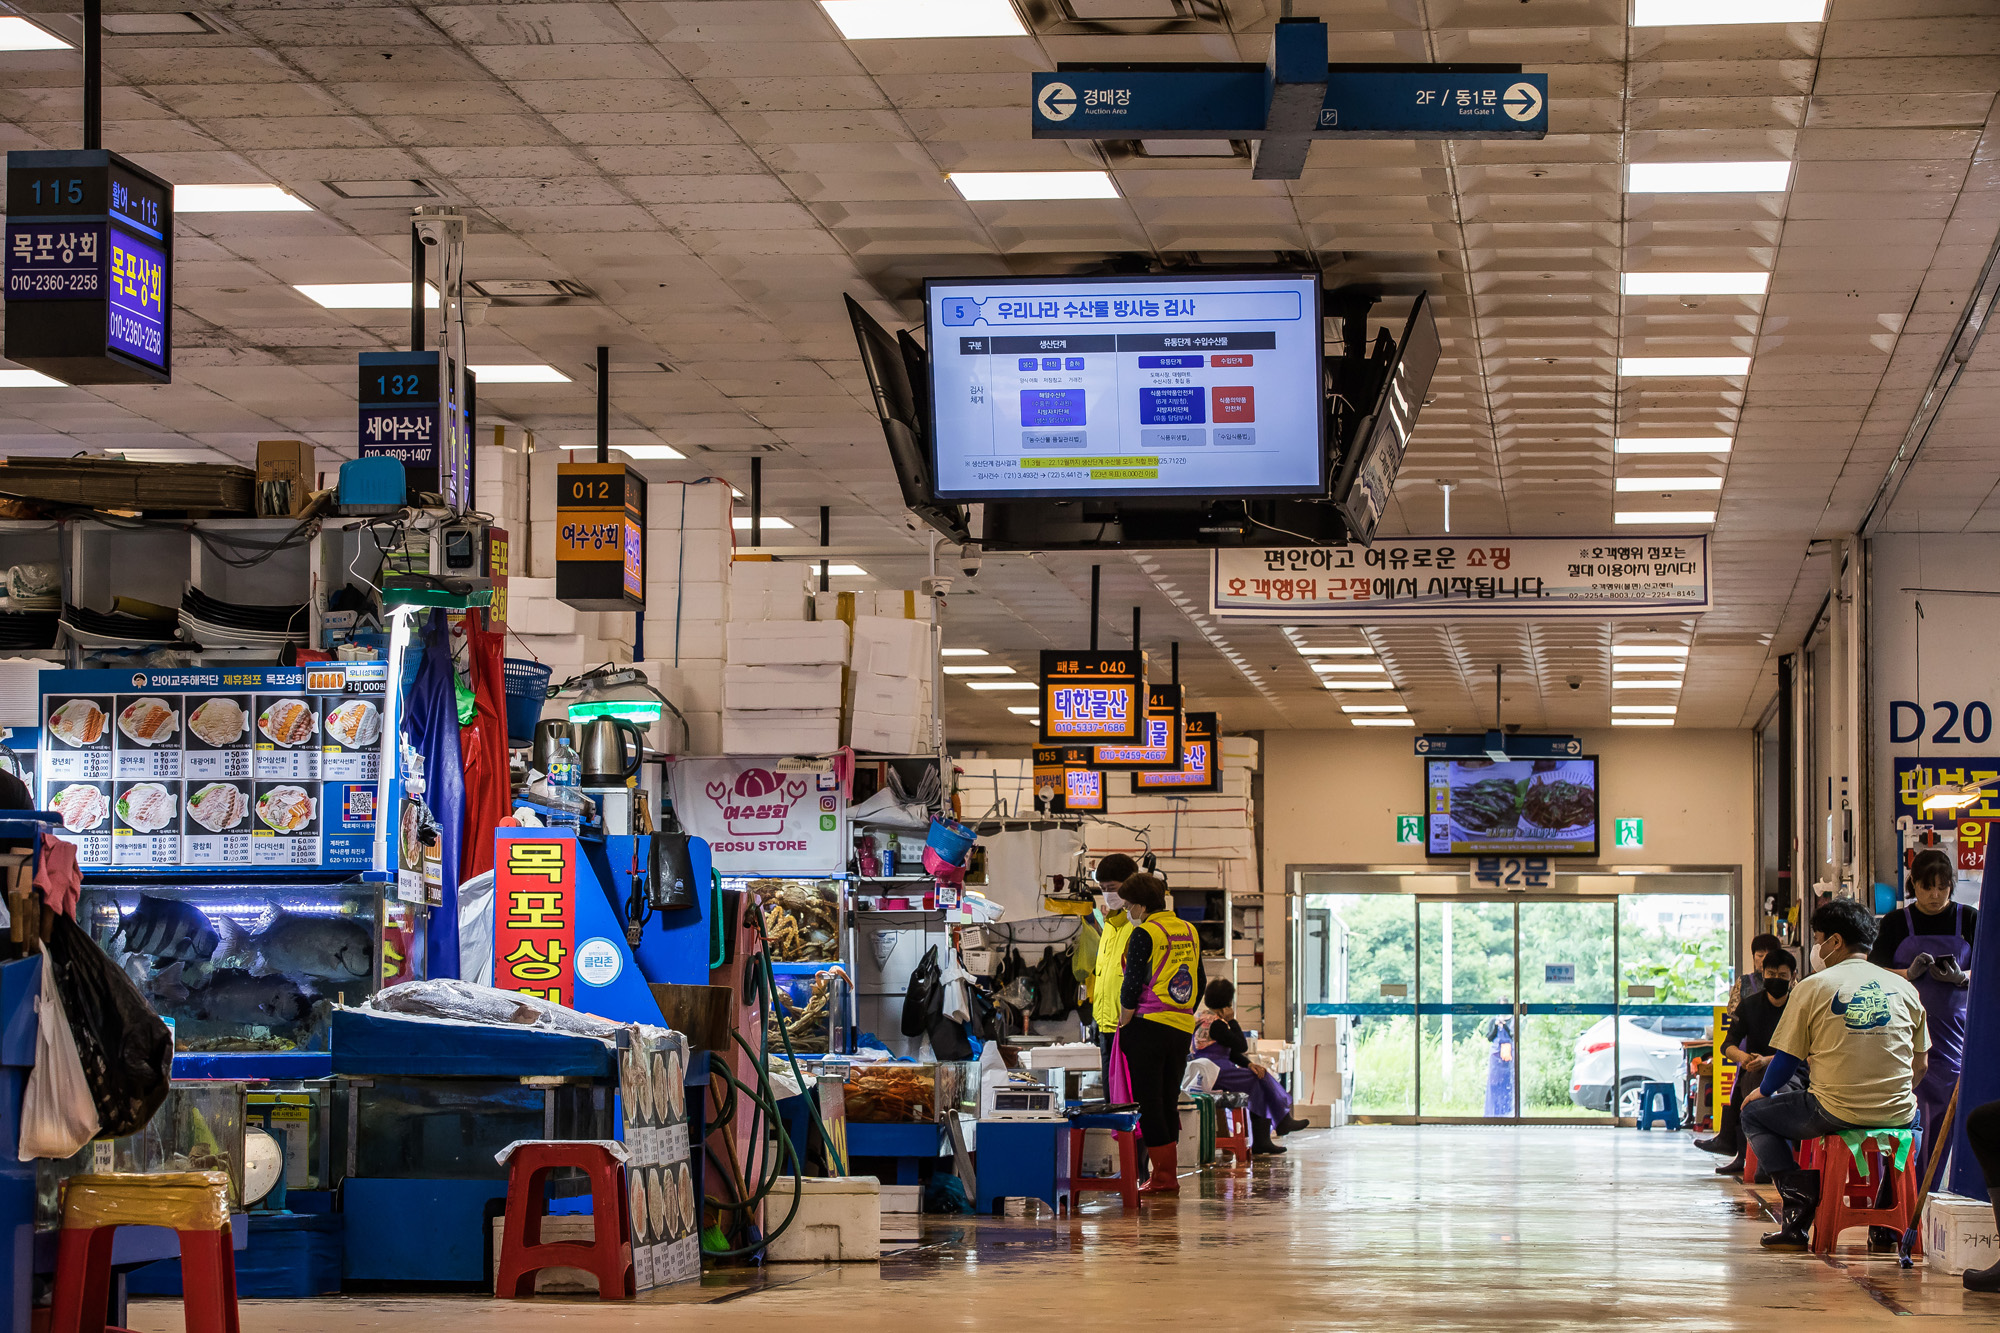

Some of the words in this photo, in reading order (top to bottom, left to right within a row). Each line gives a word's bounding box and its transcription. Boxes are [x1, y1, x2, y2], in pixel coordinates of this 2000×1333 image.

[1083, 89, 1132, 106] 경매장
[1416, 90, 1436, 105] 2F
[1455, 89, 1498, 106] 동1문
[32, 179, 83, 204] 115
[112, 181, 128, 214] 활어
[141, 196, 158, 227] 115
[12, 232, 98, 264] 목포상회
[11, 274, 98, 291] 010-2360-2258
[112, 245, 162, 313] 목포상회
[955, 305, 965, 319] 5
[998, 301, 1060, 319] 우리나라
[1063, 300, 1109, 318] 수산물
[1113, 299, 1160, 317] 방사능
[1164, 299, 1196, 317] 검사
[110, 311, 161, 356] 010-2360-2258
[1164, 337, 1191, 347] 유통단계
[968, 341, 982, 350] 구분
[1039, 340, 1067, 349] 생산단계
[1160, 358, 1182, 366] 유통단계
[377, 374, 419, 395] 132
[970, 385, 984, 395] 검사
[366, 416, 432, 441] 세아수산
[573, 481, 609, 499] 012
[562, 523, 620, 550] 여수상회
[1264, 547, 1355, 571] 편안하고
[1364, 547, 1456, 571] 여유로운
[1466, 547, 1511, 570] 쇼핑
[1647, 546, 1686, 560] 점포는
[1567, 564, 1594, 577] 절대
[1597, 563, 1650, 577] 이용하지
[1226, 577, 1317, 601] 호객행위
[1327, 577, 1418, 601] 근절에서
[1427, 576, 1551, 599] 시작됩니다.
[1056, 661, 1080, 674] 패류
[1100, 661, 1126, 673] 040
[151, 674, 219, 686] 인어교주해적단
[223, 673, 262, 685] 제휴점포
[266, 673, 304, 685] 목포상회
[1053, 688, 1129, 719] 태한물산
[1150, 694, 1164, 705] 41
[1055, 723, 1125, 733] 010-5337-1686
[1039, 751, 1056, 761] 055
[1100, 751, 1167, 760] 010-9459-4667
[723, 804, 789, 820] 여수상회
[1960, 821, 1991, 849] 우
[758, 841, 807, 852] STORE
[1475, 857, 1551, 887] 북2문
[584, 956, 613, 968] 클린존
